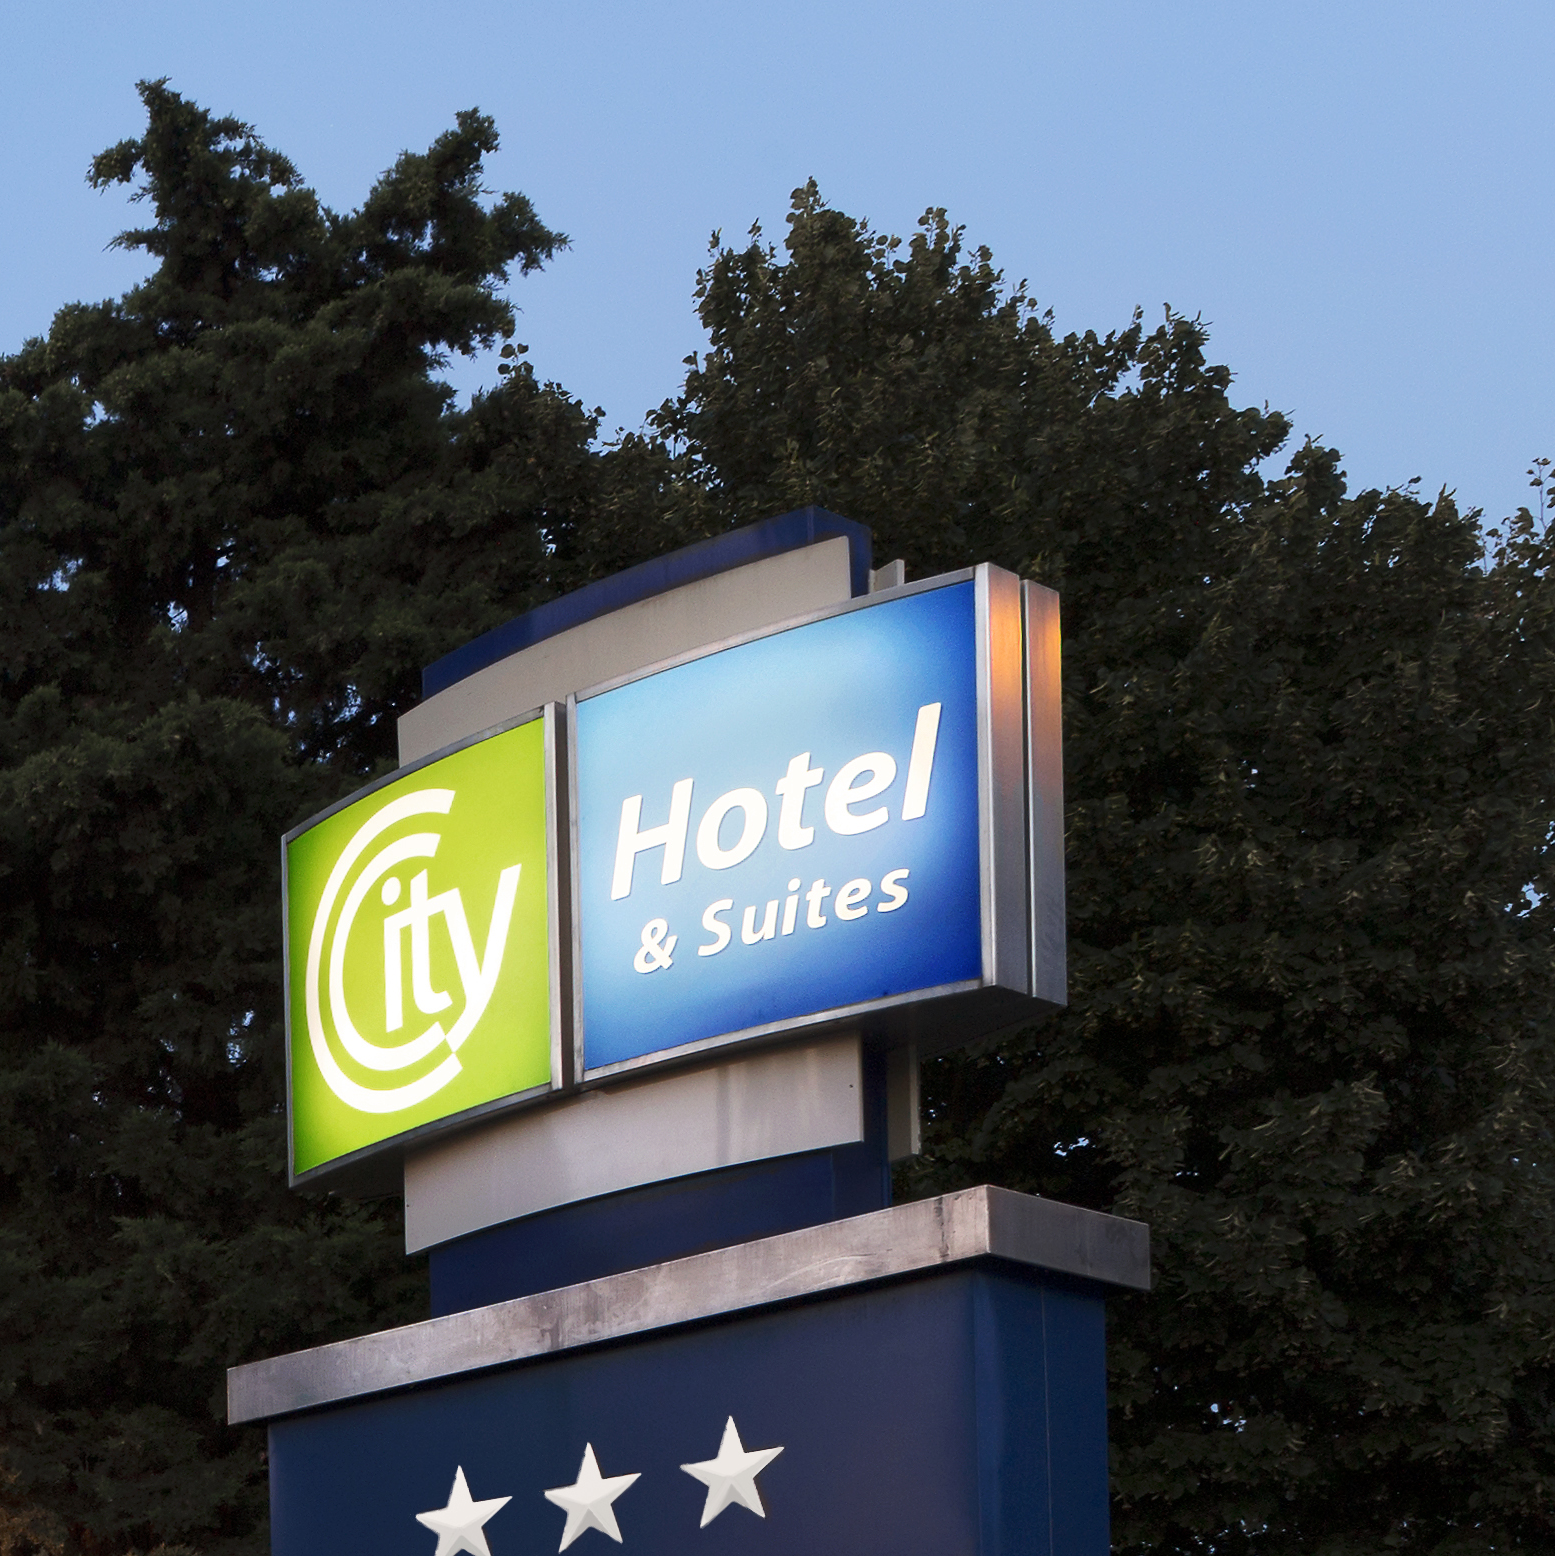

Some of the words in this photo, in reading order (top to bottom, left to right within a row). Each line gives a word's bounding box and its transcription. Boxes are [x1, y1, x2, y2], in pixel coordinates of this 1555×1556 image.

[608, 702, 943, 901] Hotel
[305, 788, 523, 1114] City
[633, 917, 679, 974] &
[697, 867, 911, 957] Suites
